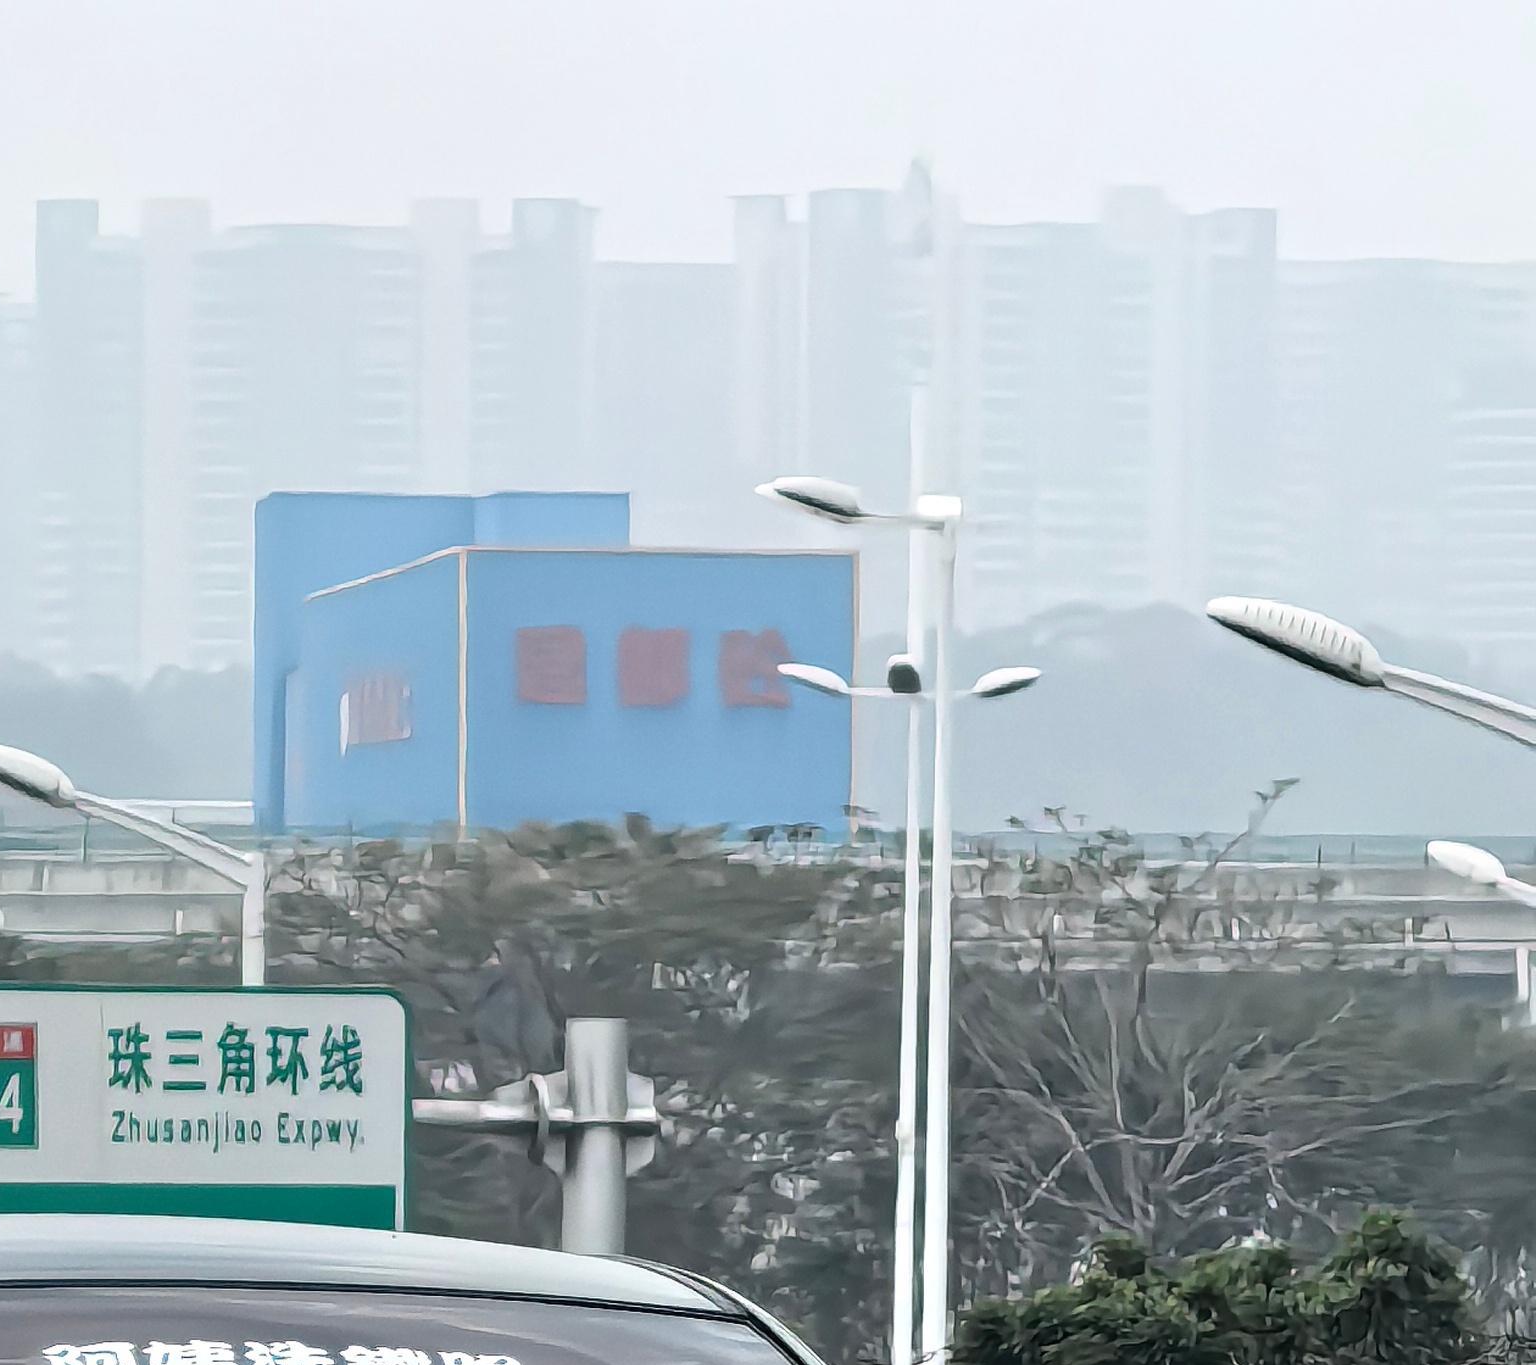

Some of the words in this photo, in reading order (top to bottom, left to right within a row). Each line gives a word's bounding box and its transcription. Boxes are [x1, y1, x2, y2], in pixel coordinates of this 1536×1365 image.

[107, 1021, 363, 1096] 珠三角环线
[111, 1110, 262, 1153] Zhusanjiao
